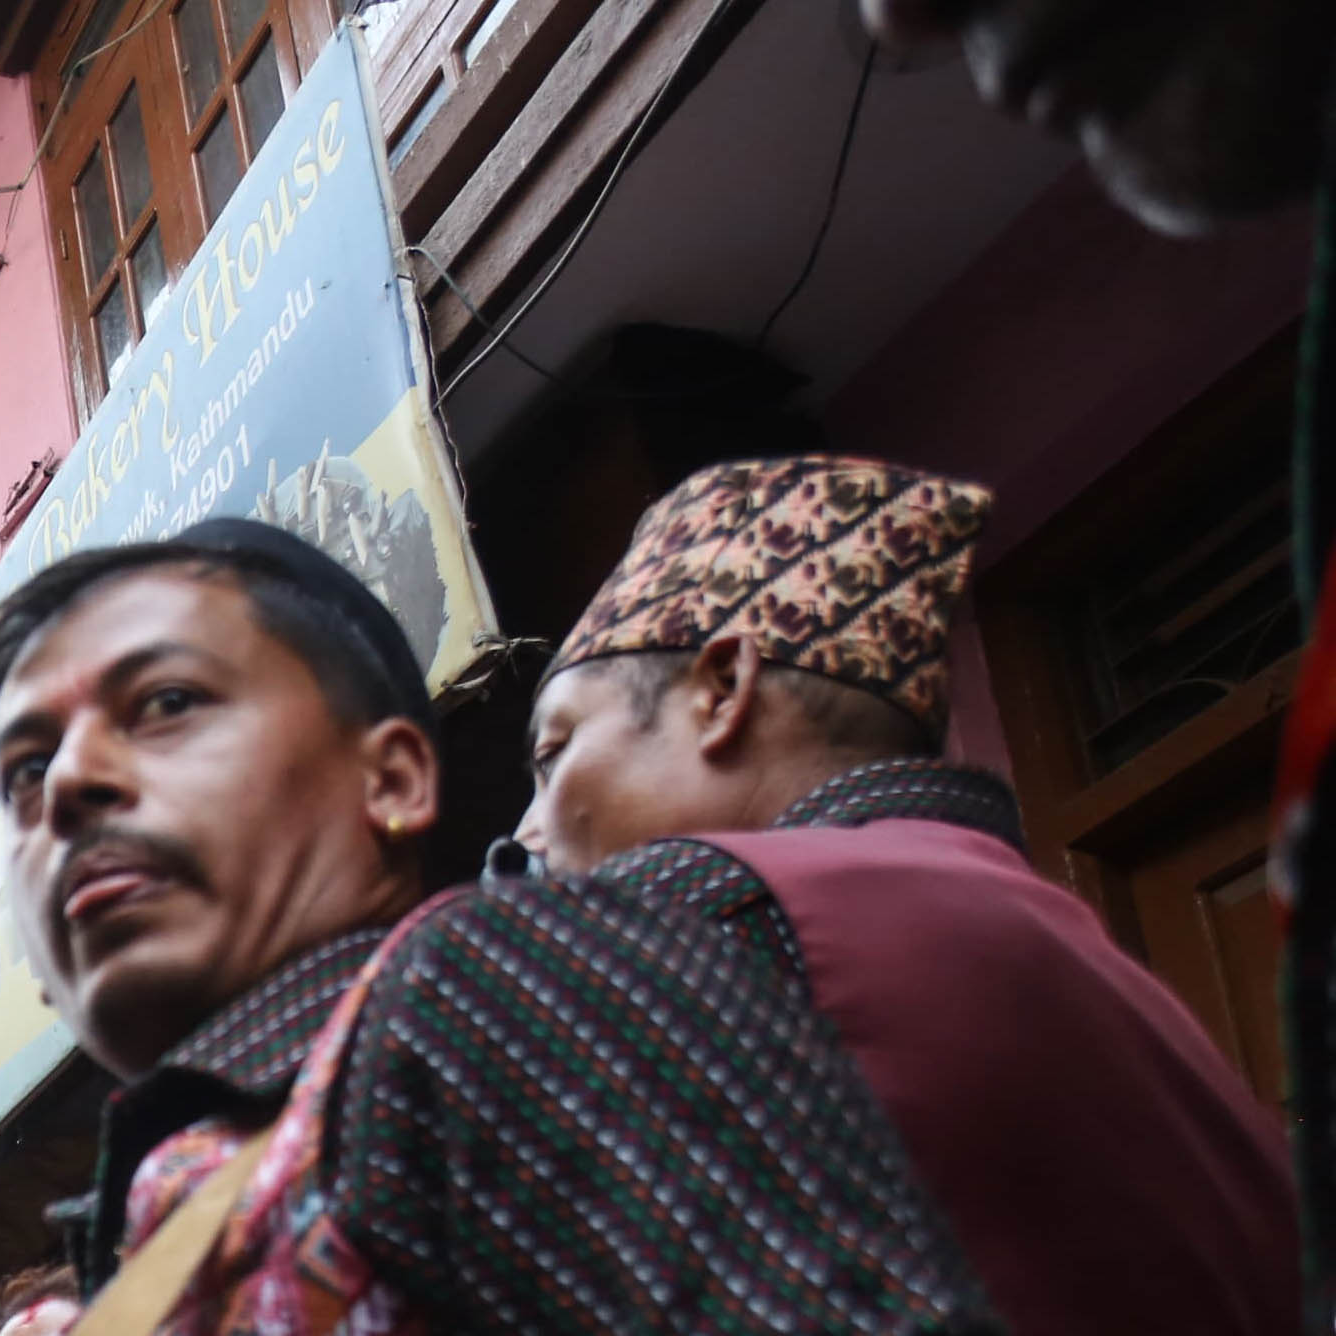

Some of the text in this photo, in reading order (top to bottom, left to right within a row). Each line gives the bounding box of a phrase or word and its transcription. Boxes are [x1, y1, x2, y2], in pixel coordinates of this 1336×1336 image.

[28, 350, 180, 577] Bakery
[182, 98, 346, 369] House
[170, 276, 314, 491] Kathmandu
